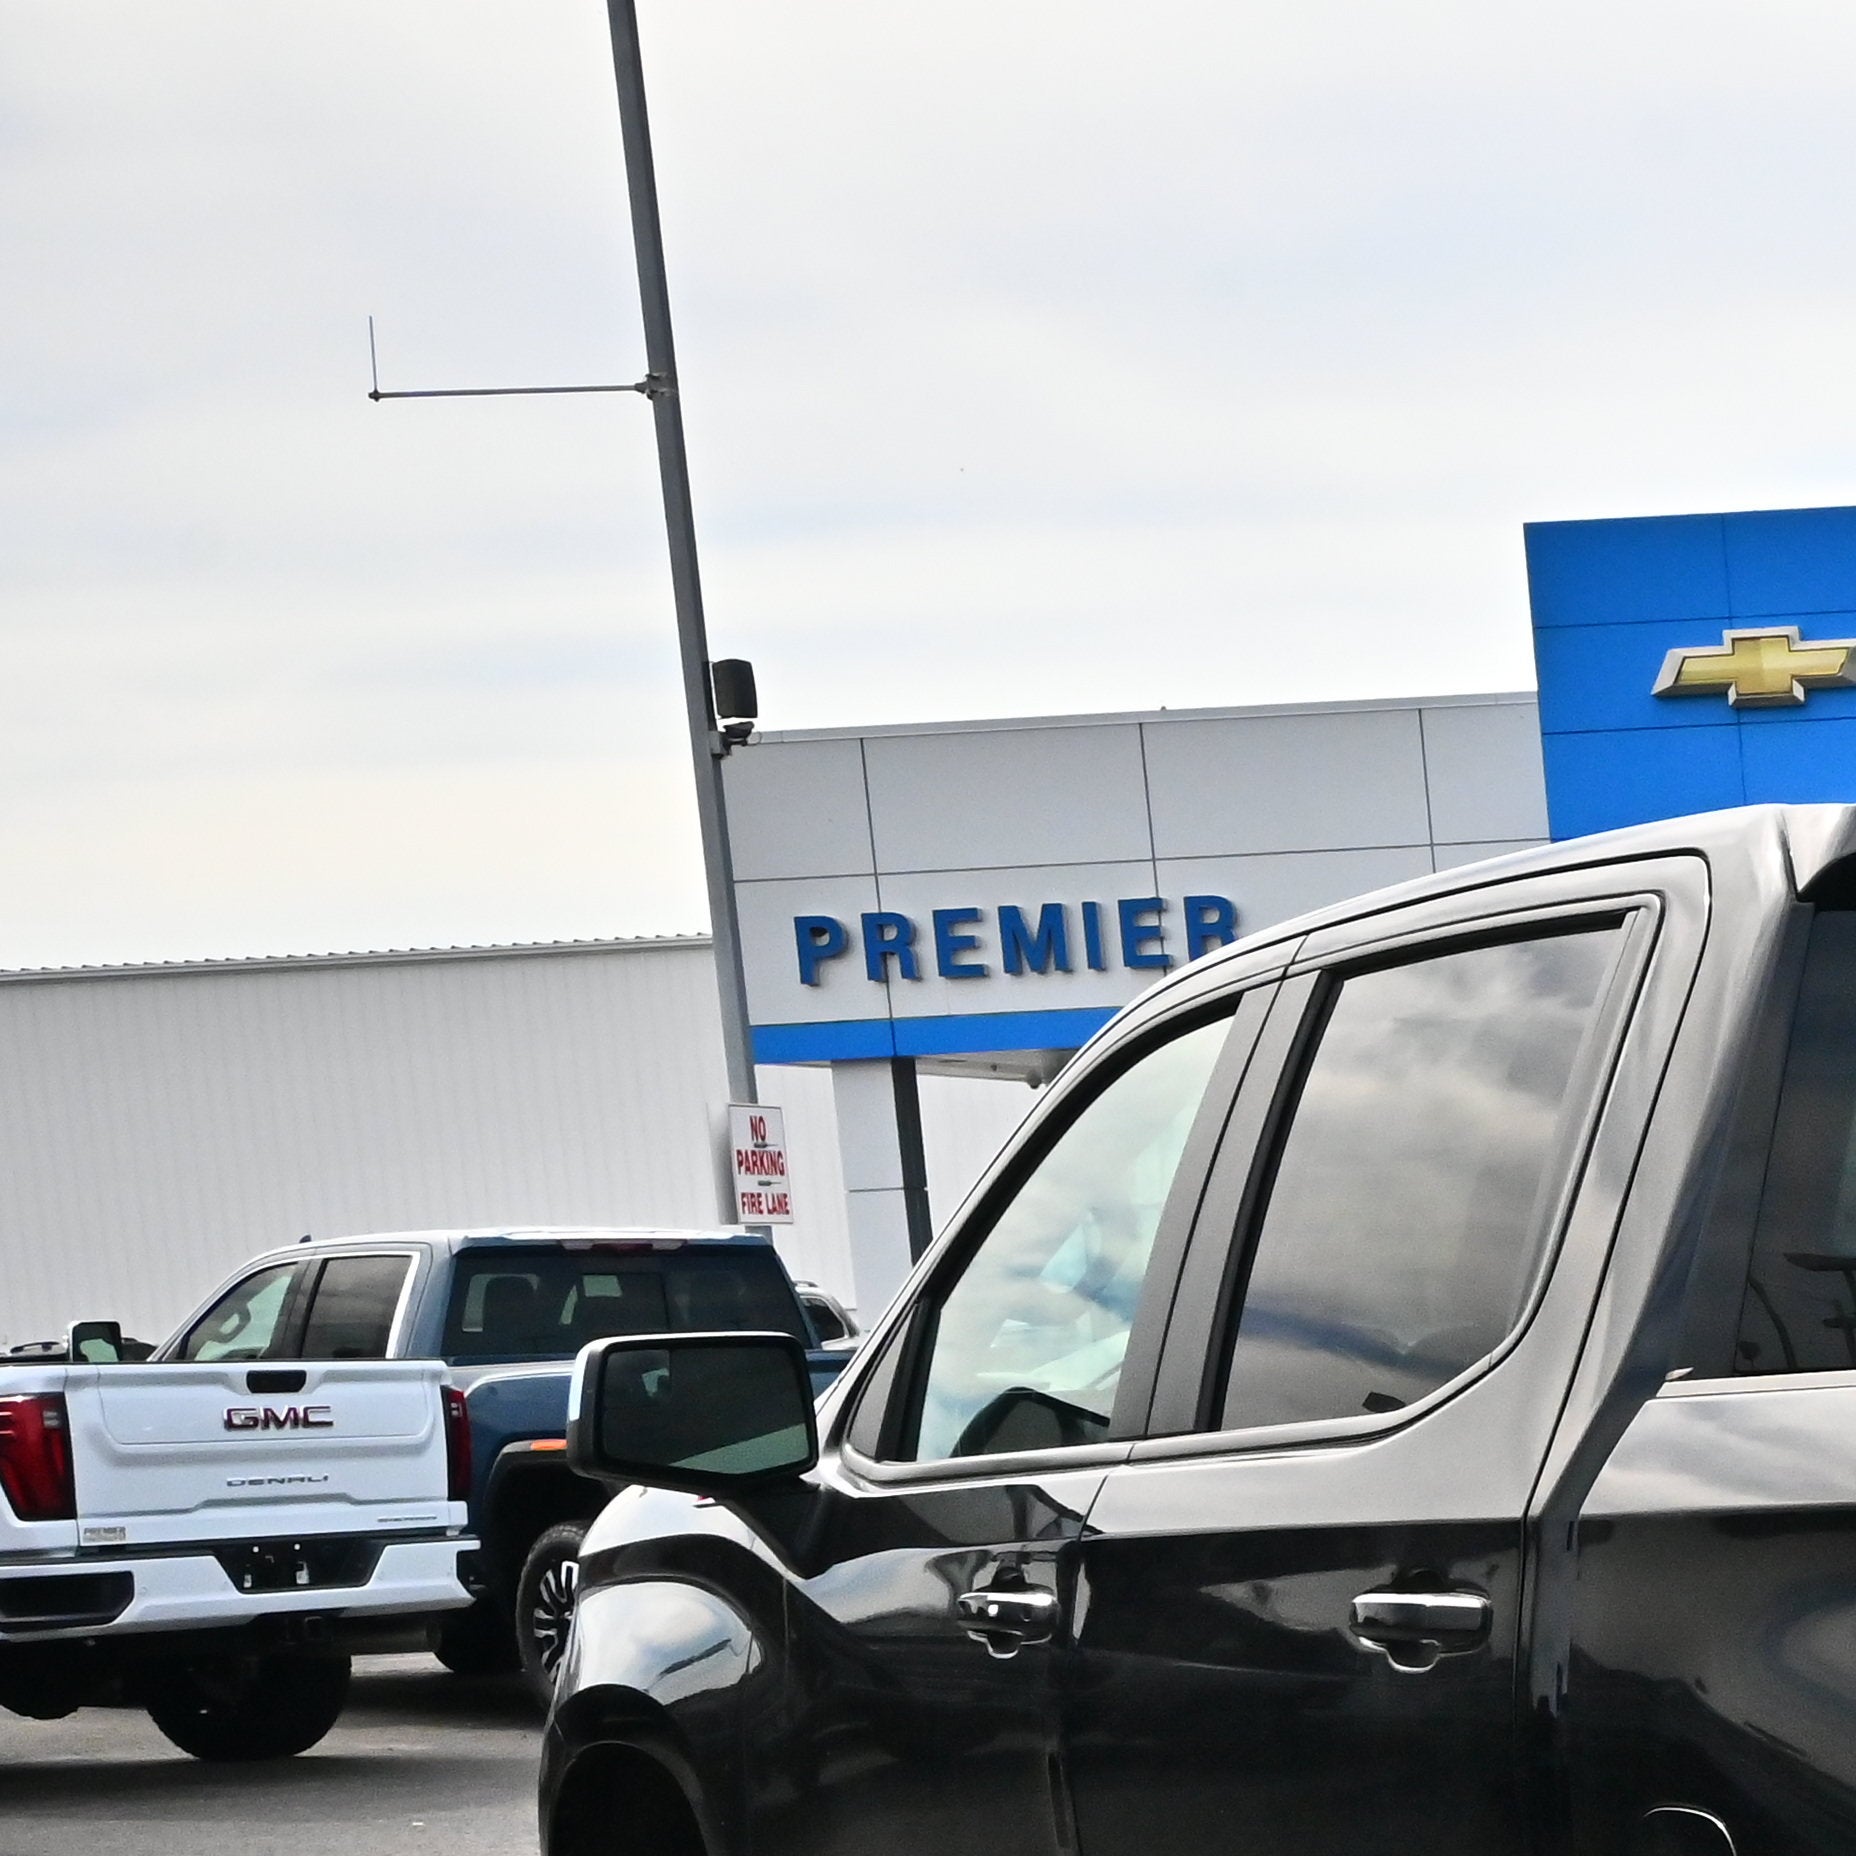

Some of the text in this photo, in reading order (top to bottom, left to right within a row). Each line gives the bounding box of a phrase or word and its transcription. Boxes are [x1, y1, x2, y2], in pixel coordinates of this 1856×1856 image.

[793, 894, 1242, 987] PREMIER
[749, 1115, 767, 1142] NO
[736, 1149, 785, 1176] PARKING
[741, 1192, 790, 1215] FIRE LANE
[223, 1405, 333, 1431] GMC
[226, 1474, 329, 1487] DENALI
